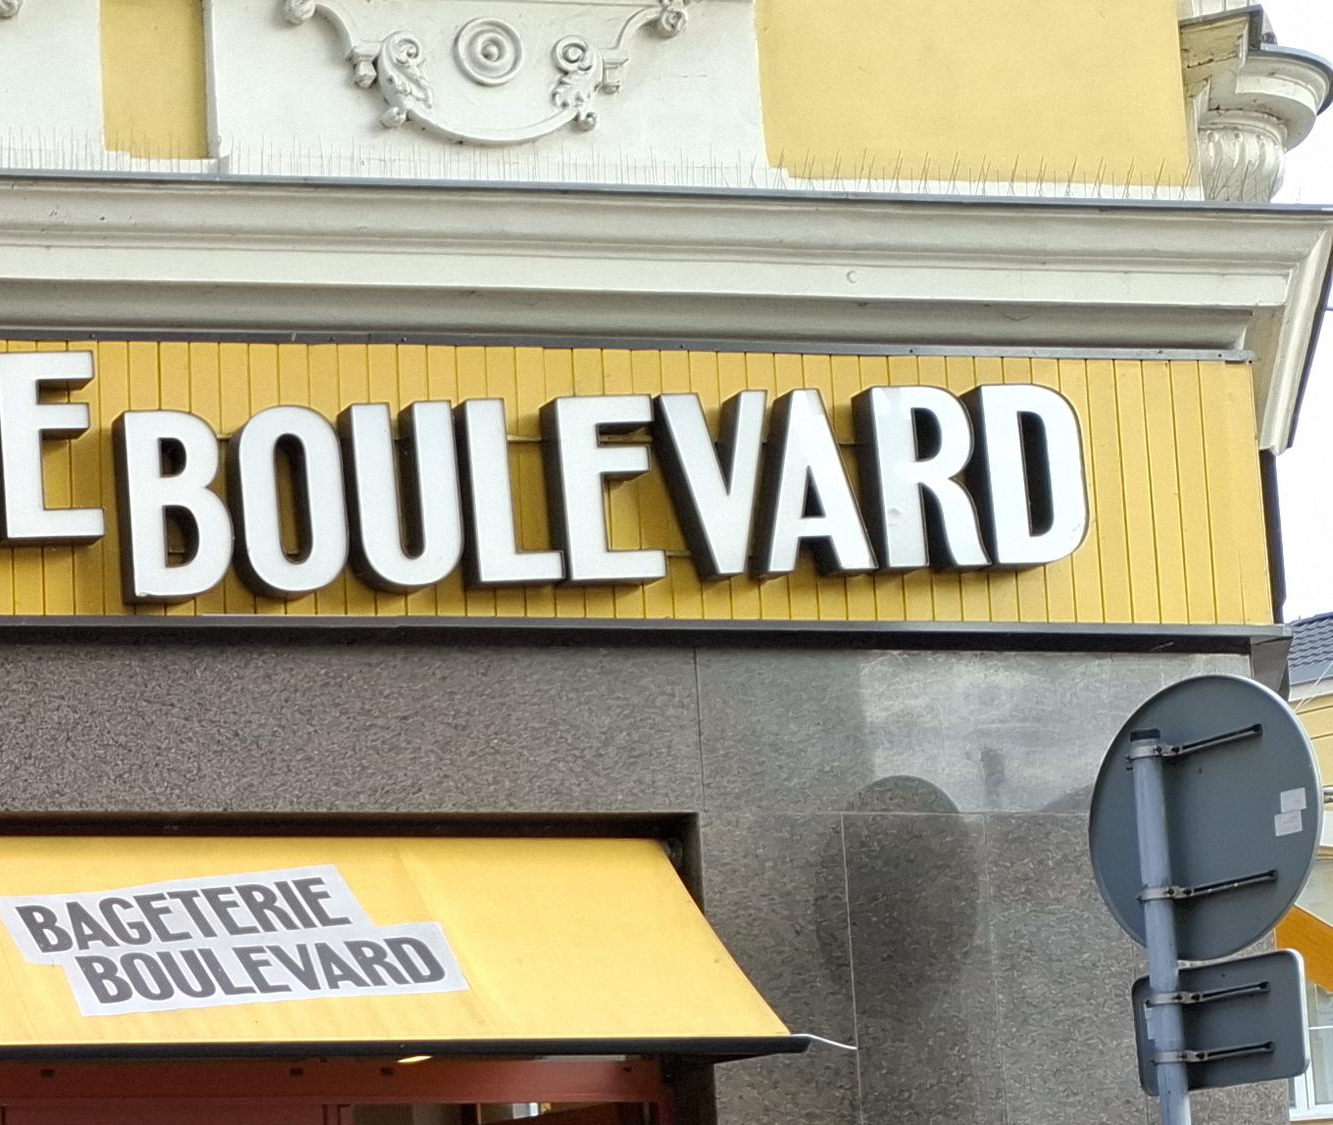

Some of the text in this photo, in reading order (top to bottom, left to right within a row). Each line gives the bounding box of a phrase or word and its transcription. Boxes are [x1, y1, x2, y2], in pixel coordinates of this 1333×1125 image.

[118, 383, 1088, 601] BOULEVARD
[15, 876, 353, 954] BAGETERIE
[74, 935, 446, 1004] BOULEVARD
